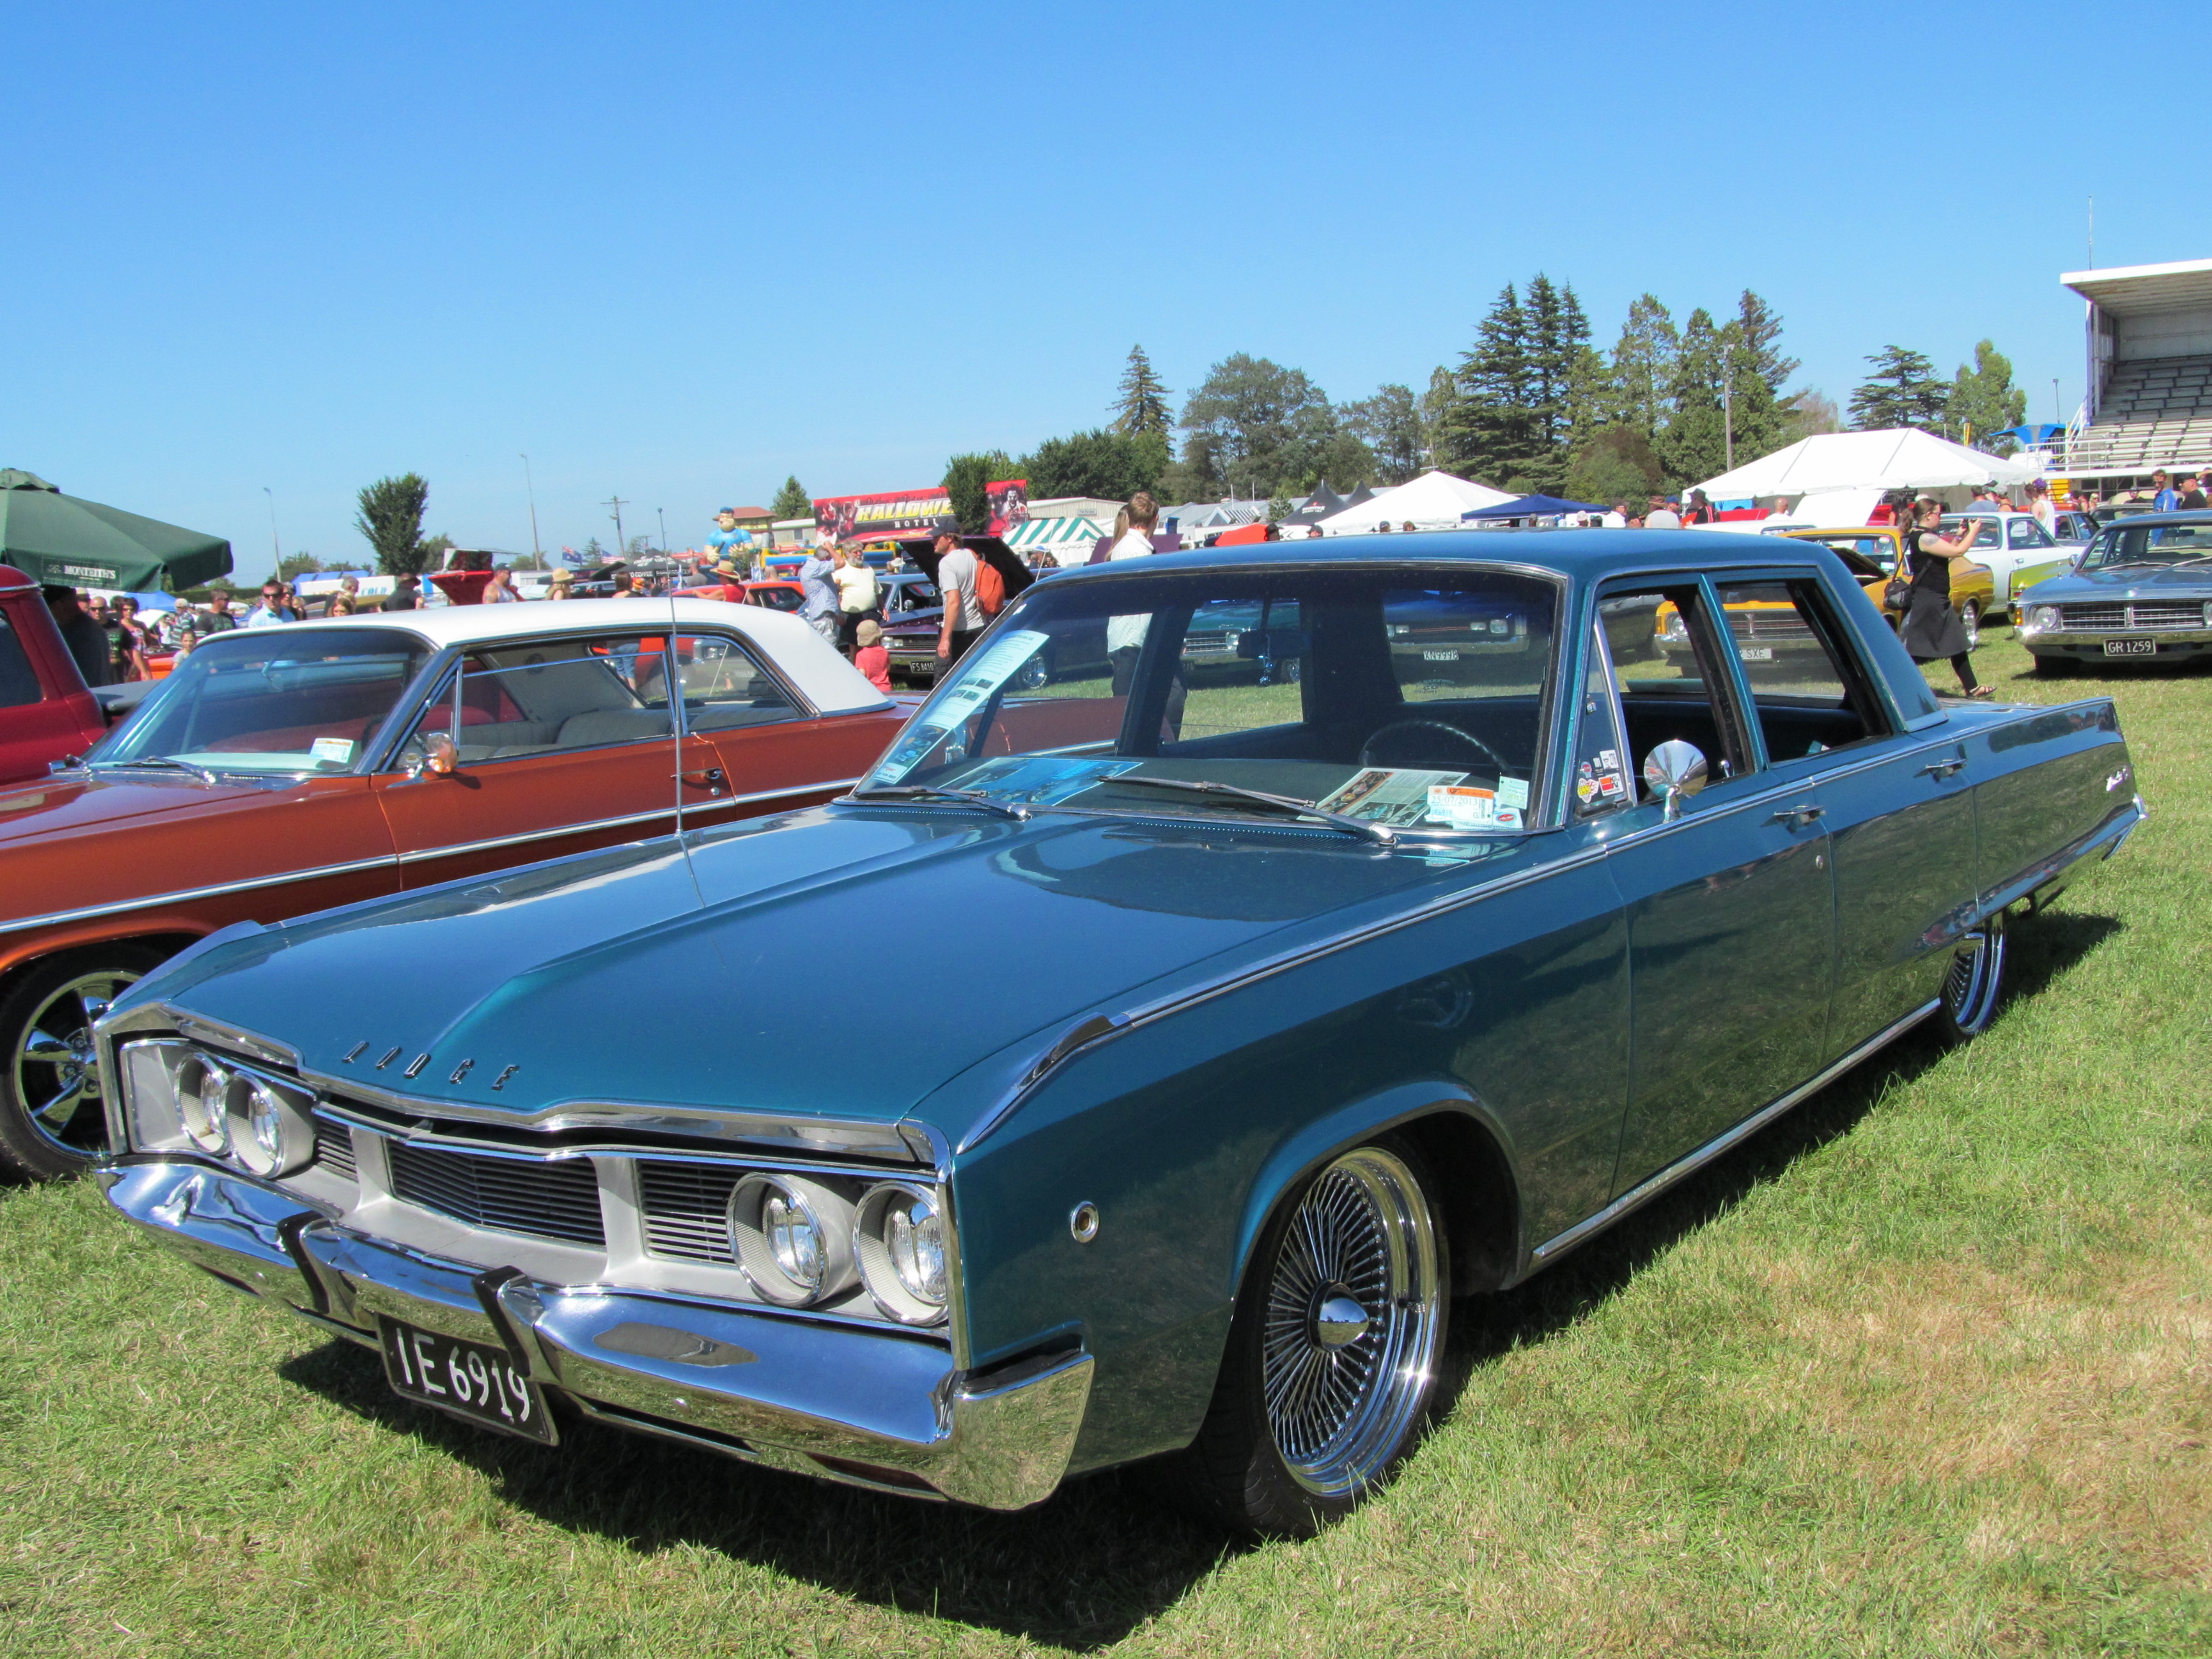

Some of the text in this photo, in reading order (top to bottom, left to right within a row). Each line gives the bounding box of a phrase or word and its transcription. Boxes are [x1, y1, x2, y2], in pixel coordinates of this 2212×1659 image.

[855, 498, 955, 523] HALLOWE
[894, 517, 939, 529] HOTEL
[63, 565, 117, 579] MONTEITH'S
[361, 587, 387, 595] COLD
[2108, 641, 2152, 653] GR 1259
[1746, 648, 1765, 659] SXE
[1431, 796, 1478, 806] 25/07/2013
